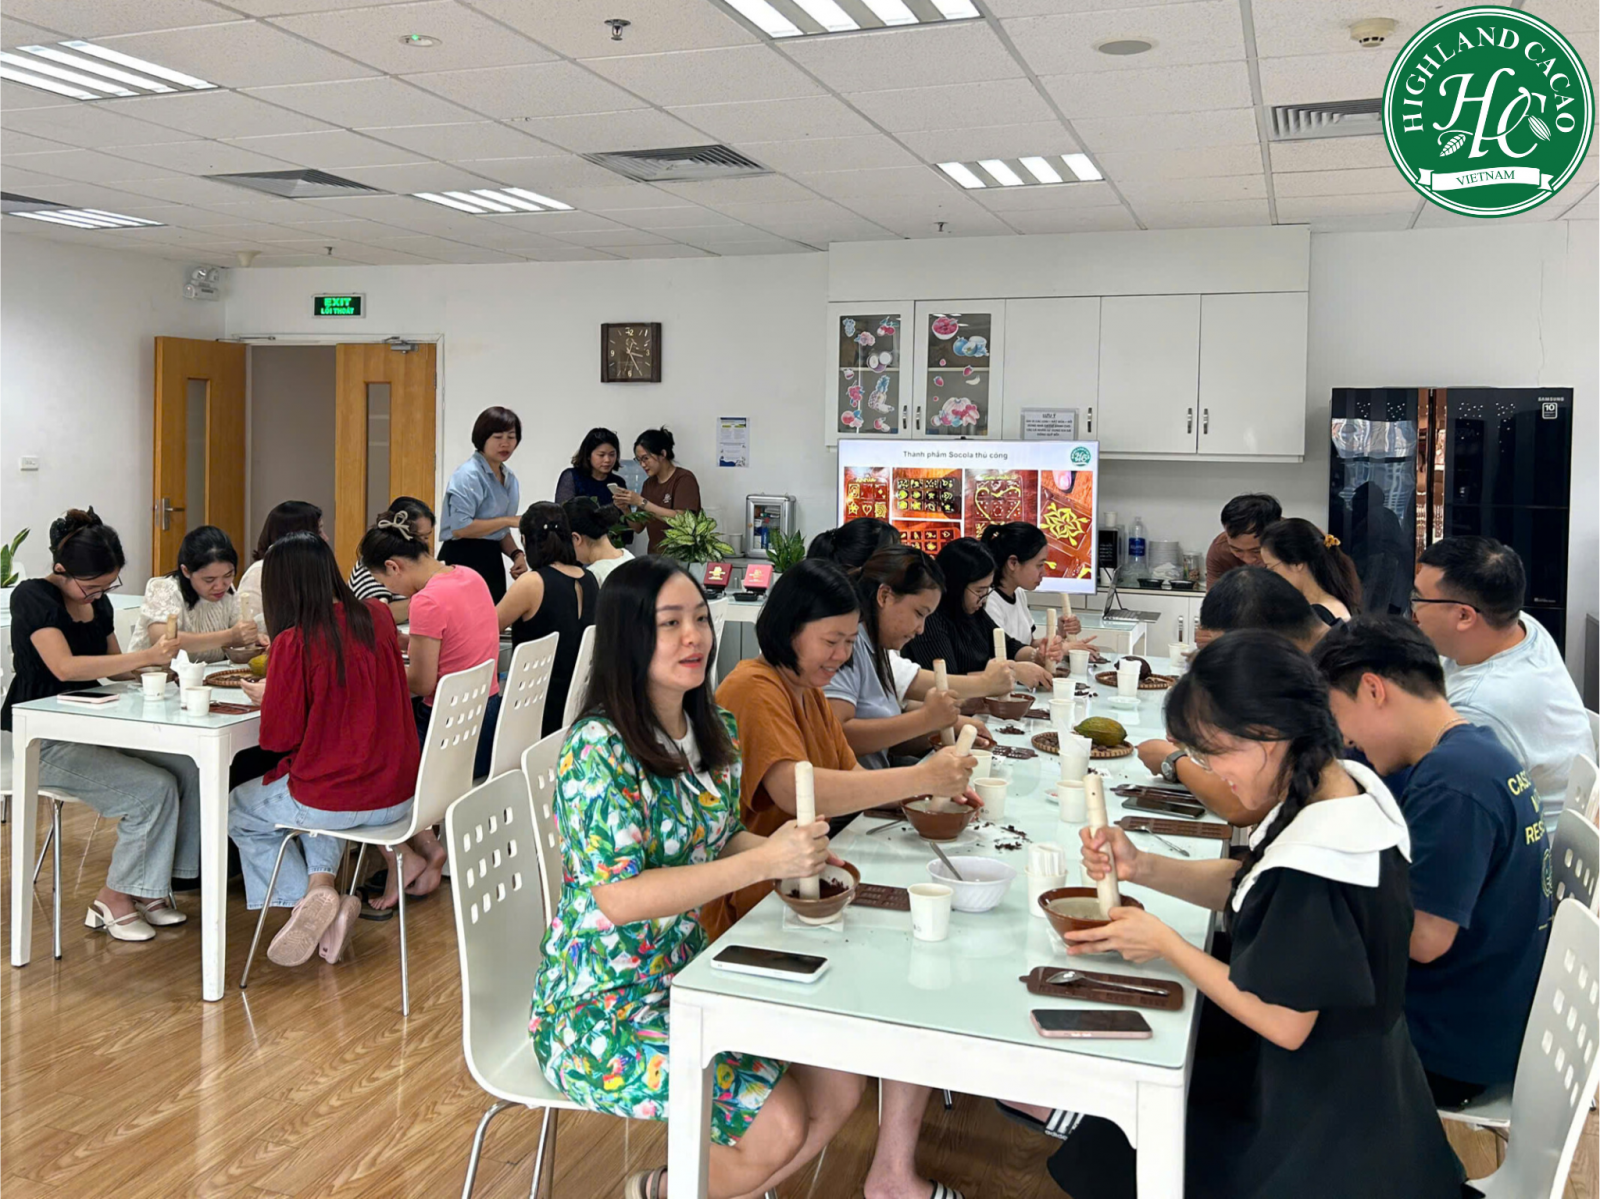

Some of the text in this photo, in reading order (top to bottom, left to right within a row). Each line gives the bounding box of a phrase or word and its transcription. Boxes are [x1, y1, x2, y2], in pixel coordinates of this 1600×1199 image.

[324, 297, 352, 307] EXIT
[1545, 403, 1555, 411] 10
[948, 450, 974, 459] Socola
